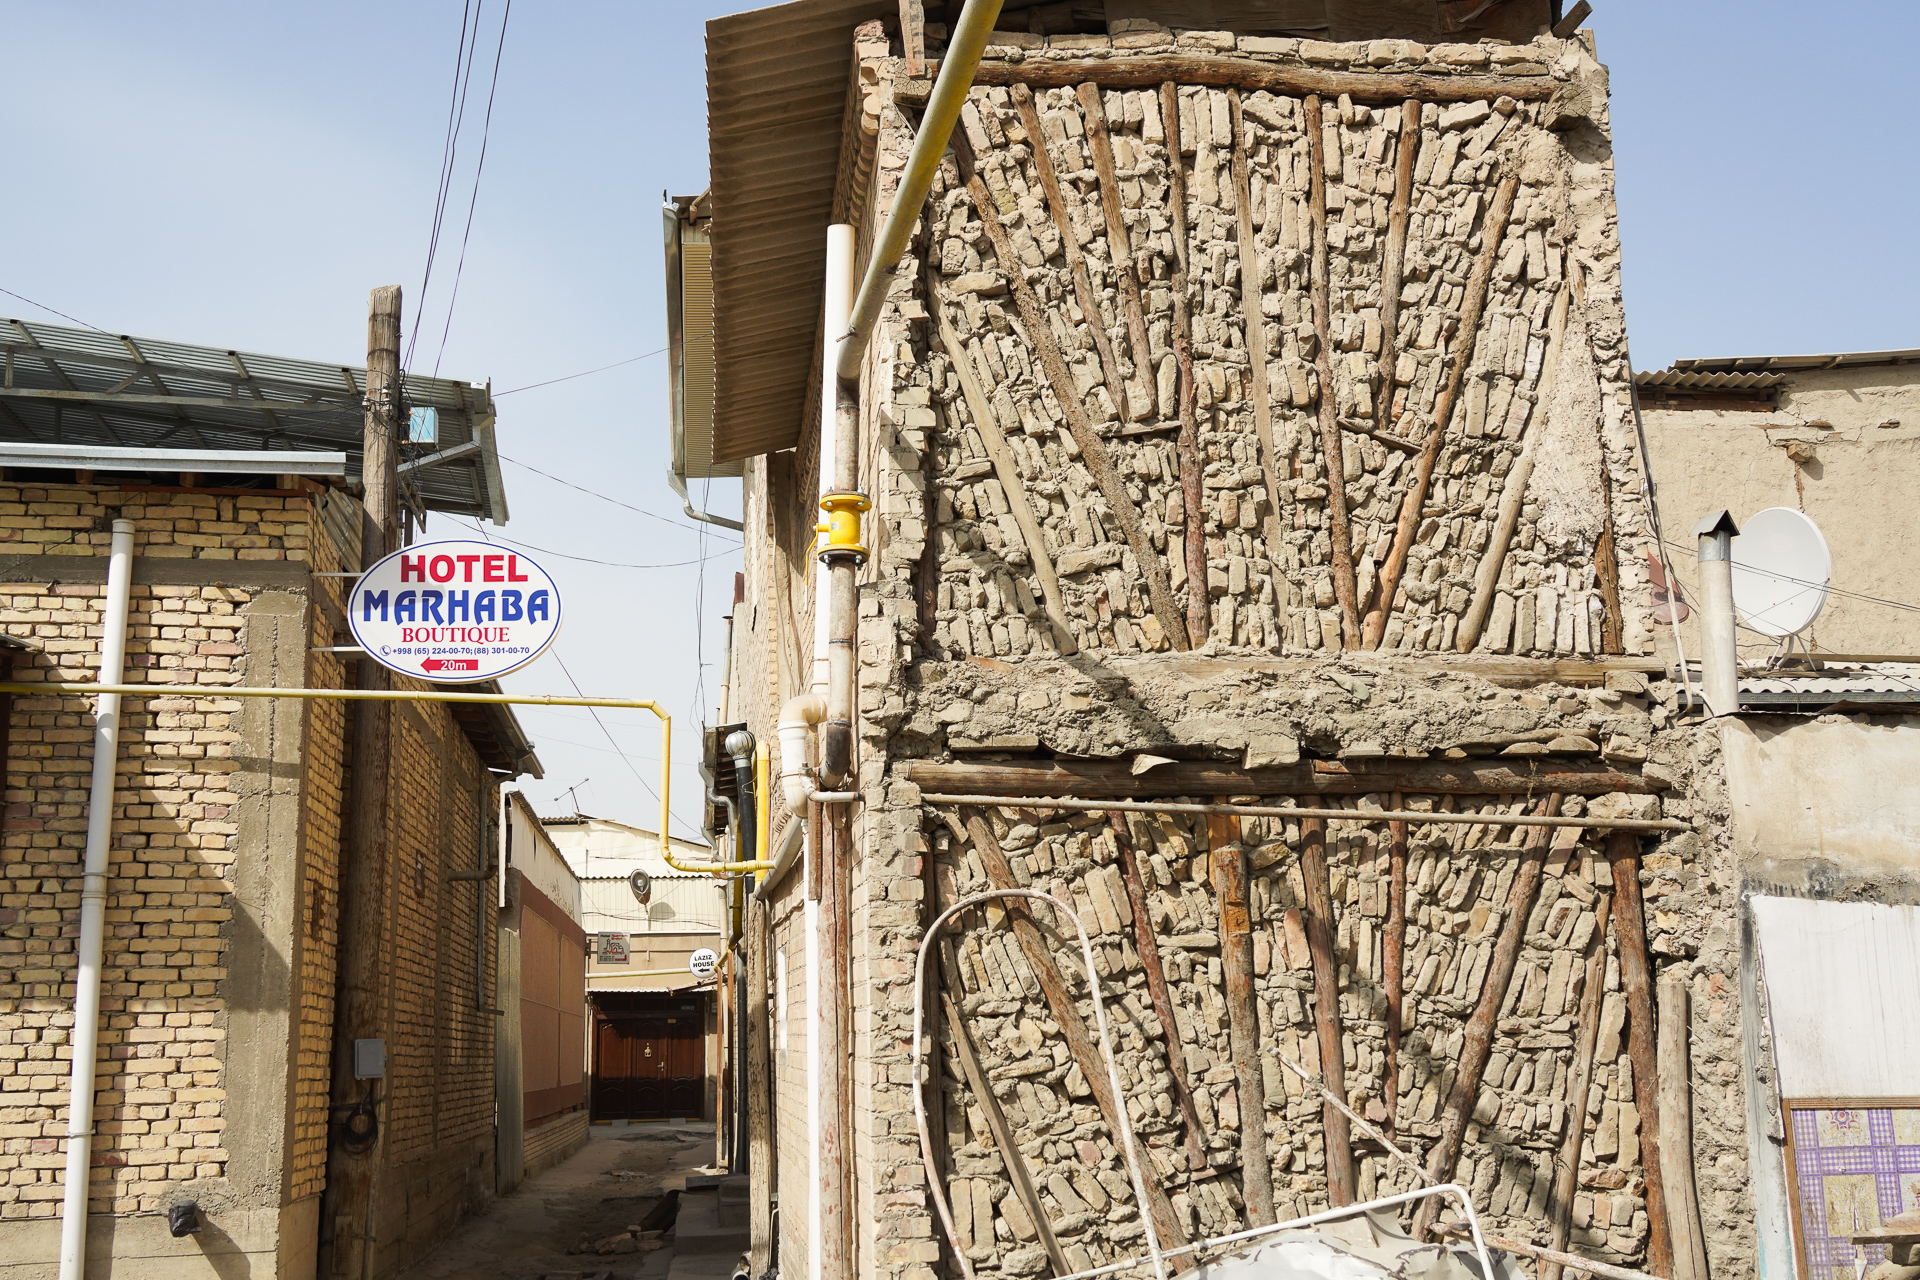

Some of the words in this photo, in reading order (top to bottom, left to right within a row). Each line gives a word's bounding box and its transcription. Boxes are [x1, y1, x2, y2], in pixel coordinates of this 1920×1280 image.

[400, 554, 529, 583] HOTEL
[363, 589, 550, 626] MARHABA
[401, 627, 510, 644] BOUTIQUE
[392, 647, 412, 655] +998
[414, 647, 430, 656] (65)
[491, 646, 530, 655] 301-00-70
[440, 659, 467, 671] 20m
[692, 960, 715, 968] HOUSE
